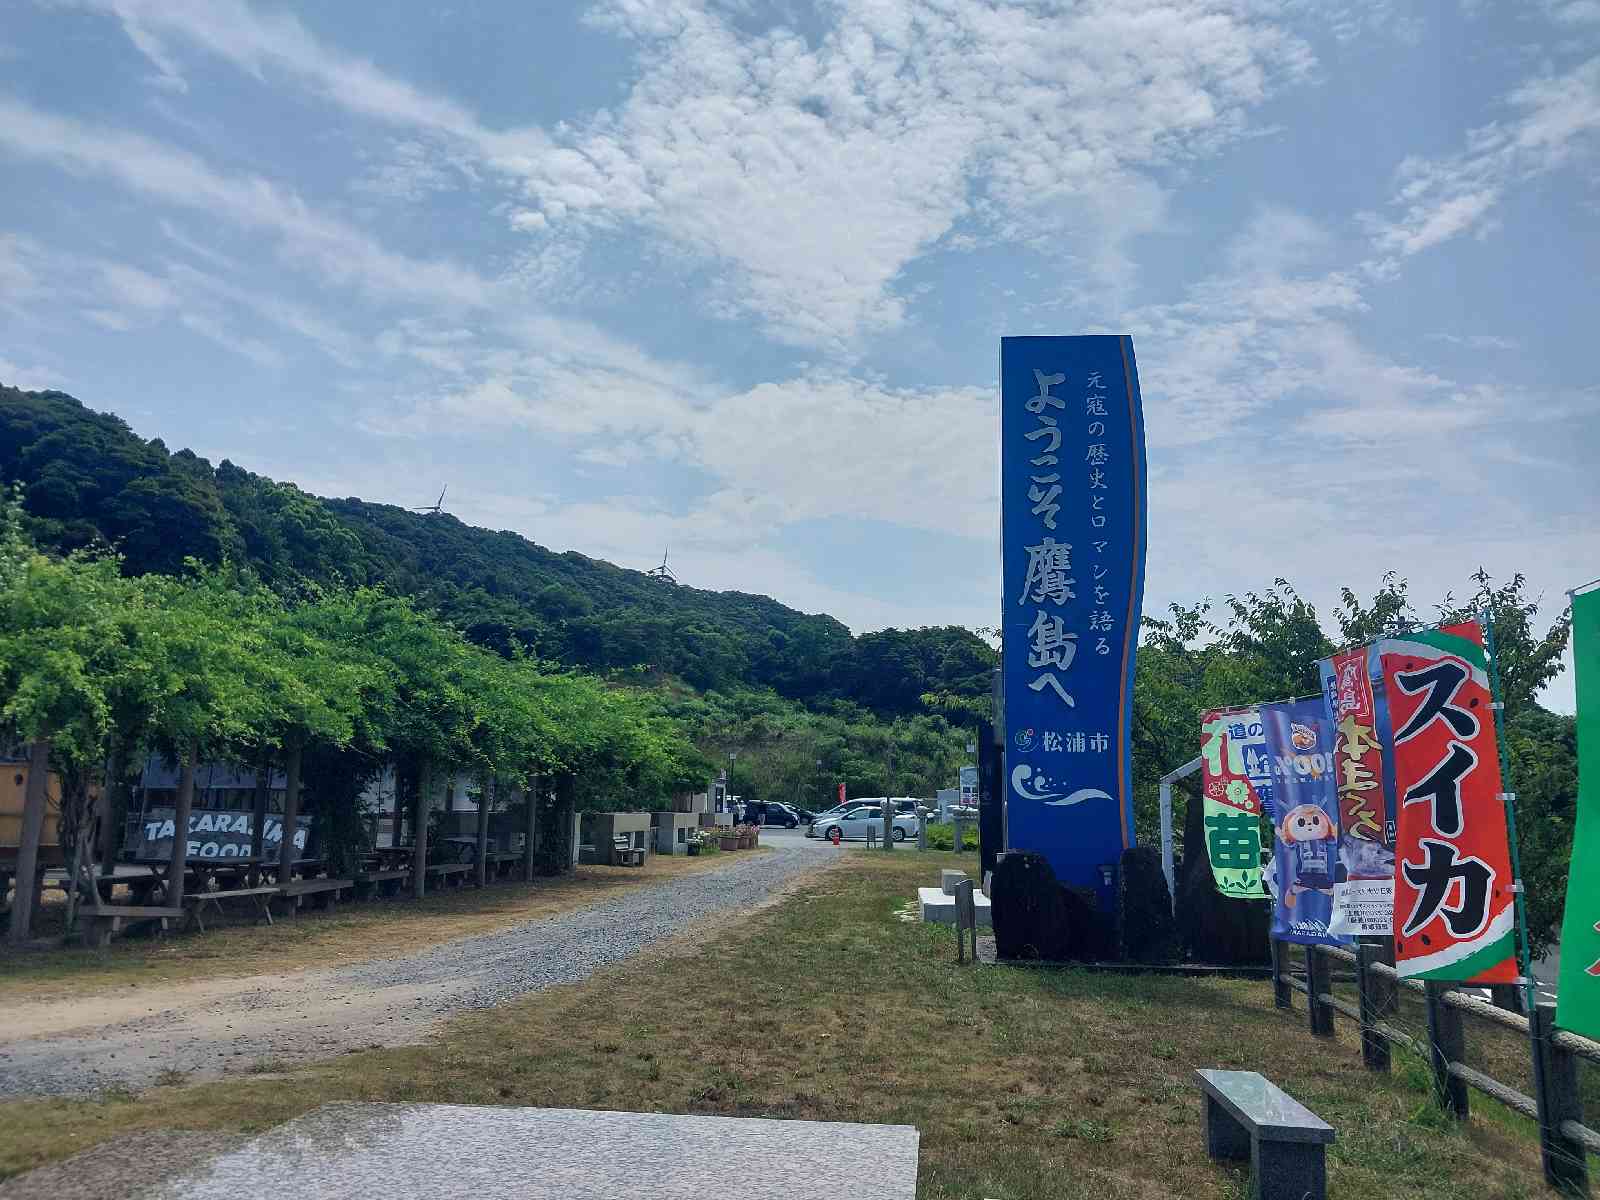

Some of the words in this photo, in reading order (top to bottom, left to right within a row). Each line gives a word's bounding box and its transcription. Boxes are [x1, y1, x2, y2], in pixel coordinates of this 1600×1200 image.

[1018, 368, 1079, 708] ようこそ鷹島へ
[1085, 371, 1114, 656] 元寇の歴史とロマンを語る
[185, 840, 252, 858] FOOD
[1043, 731, 1110, 753] 松浦市
[1394, 662, 1495, 938] スイカ
